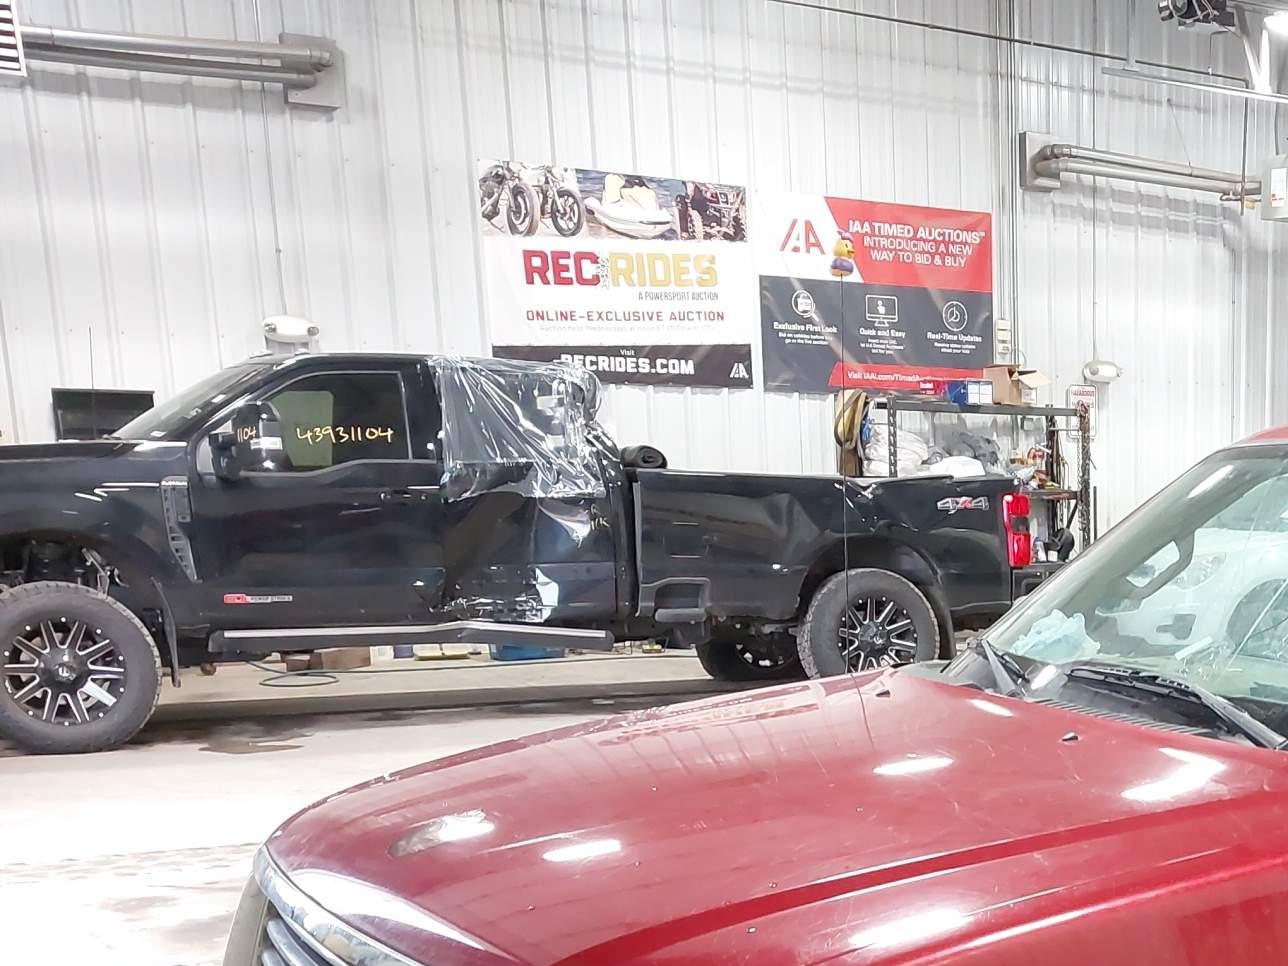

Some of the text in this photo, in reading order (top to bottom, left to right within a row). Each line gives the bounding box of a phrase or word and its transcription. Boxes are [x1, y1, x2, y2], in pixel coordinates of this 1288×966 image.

[849, 219, 871, 234] IAA
[872, 221, 914, 239] TIMED
[863, 236, 973, 256] INTRODUCING A NEW
[870, 250, 967, 267] WAY TO BID & BUY
[522, 249, 600, 286] REC
[608, 252, 719, 288] RIDES
[638, 291, 719, 301] A POWERSPORT AUCTION
[526, 310, 725, 322] ONLINE-EXCLUSIVE AUCTION
[773, 321, 805, 331] Exclusive
[806, 323, 821, 332] First
[860, 328, 906, 339] Quick and Easy
[927, 331, 982, 343] Real-Time Updates
[847, 371, 863, 380] Visit
[296, 426, 395, 445] 43931104
